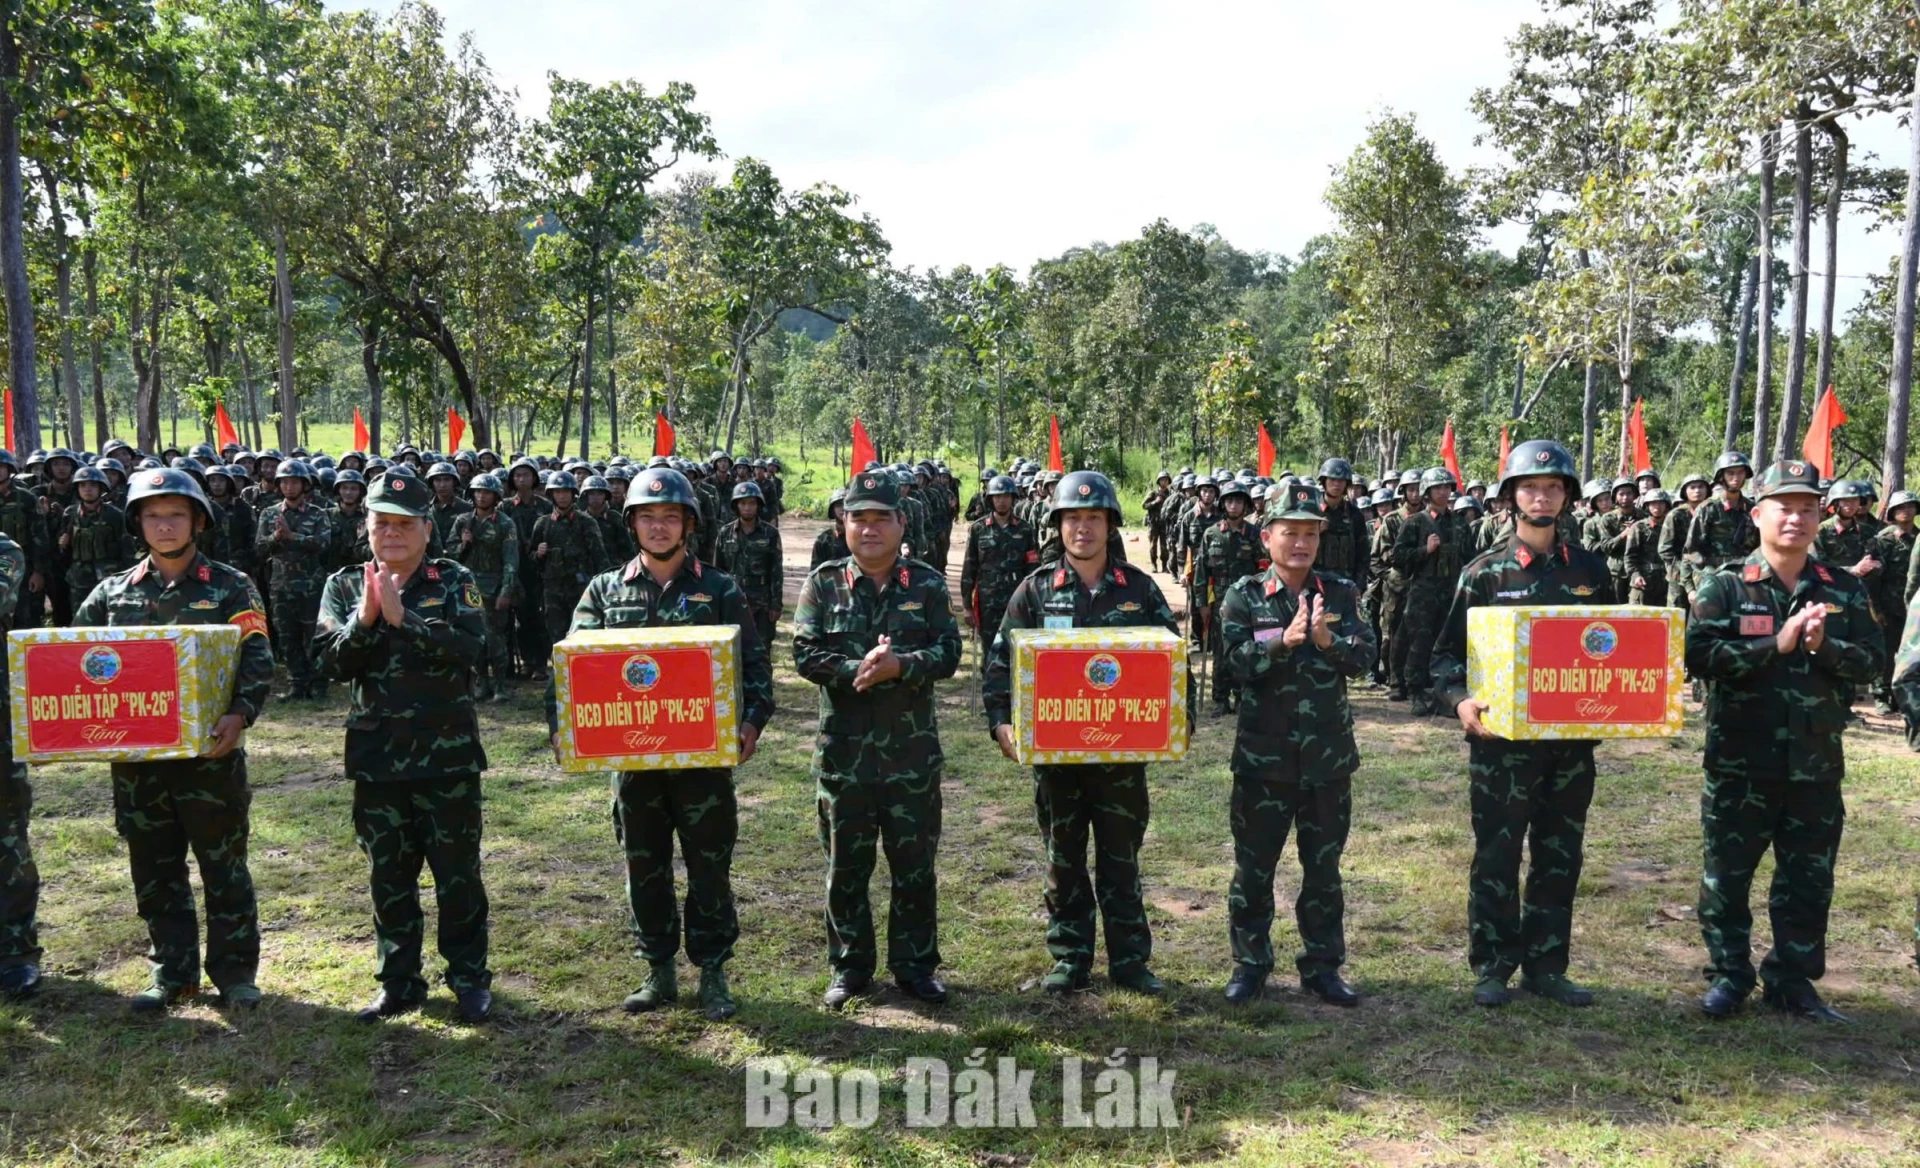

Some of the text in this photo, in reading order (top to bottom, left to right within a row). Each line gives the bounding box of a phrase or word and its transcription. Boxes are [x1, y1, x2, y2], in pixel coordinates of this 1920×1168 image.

[1532, 668, 1557, 693] BCĐ
[1560, 659, 1587, 693] DIỄN
[1590, 662, 1612, 698] TẬP
[32, 695, 59, 721] BCĐ
[62, 684, 91, 720] DIỄN
[94, 687, 119, 724] TẬP
[576, 703, 602, 728] BCĐ
[604, 692, 632, 727] DIỄN
[634, 695, 658, 730] TẬP
[1038, 698, 1062, 722] BCĐ
[1065, 689, 1091, 722] DIỄN
[1094, 693, 1116, 727] TẬP
[1575, 698, 1618, 720] Tặng
[81, 724, 129, 746] Tặng
[623, 730, 667, 750] Tặng
[1080, 726, 1123, 748] Tặng
